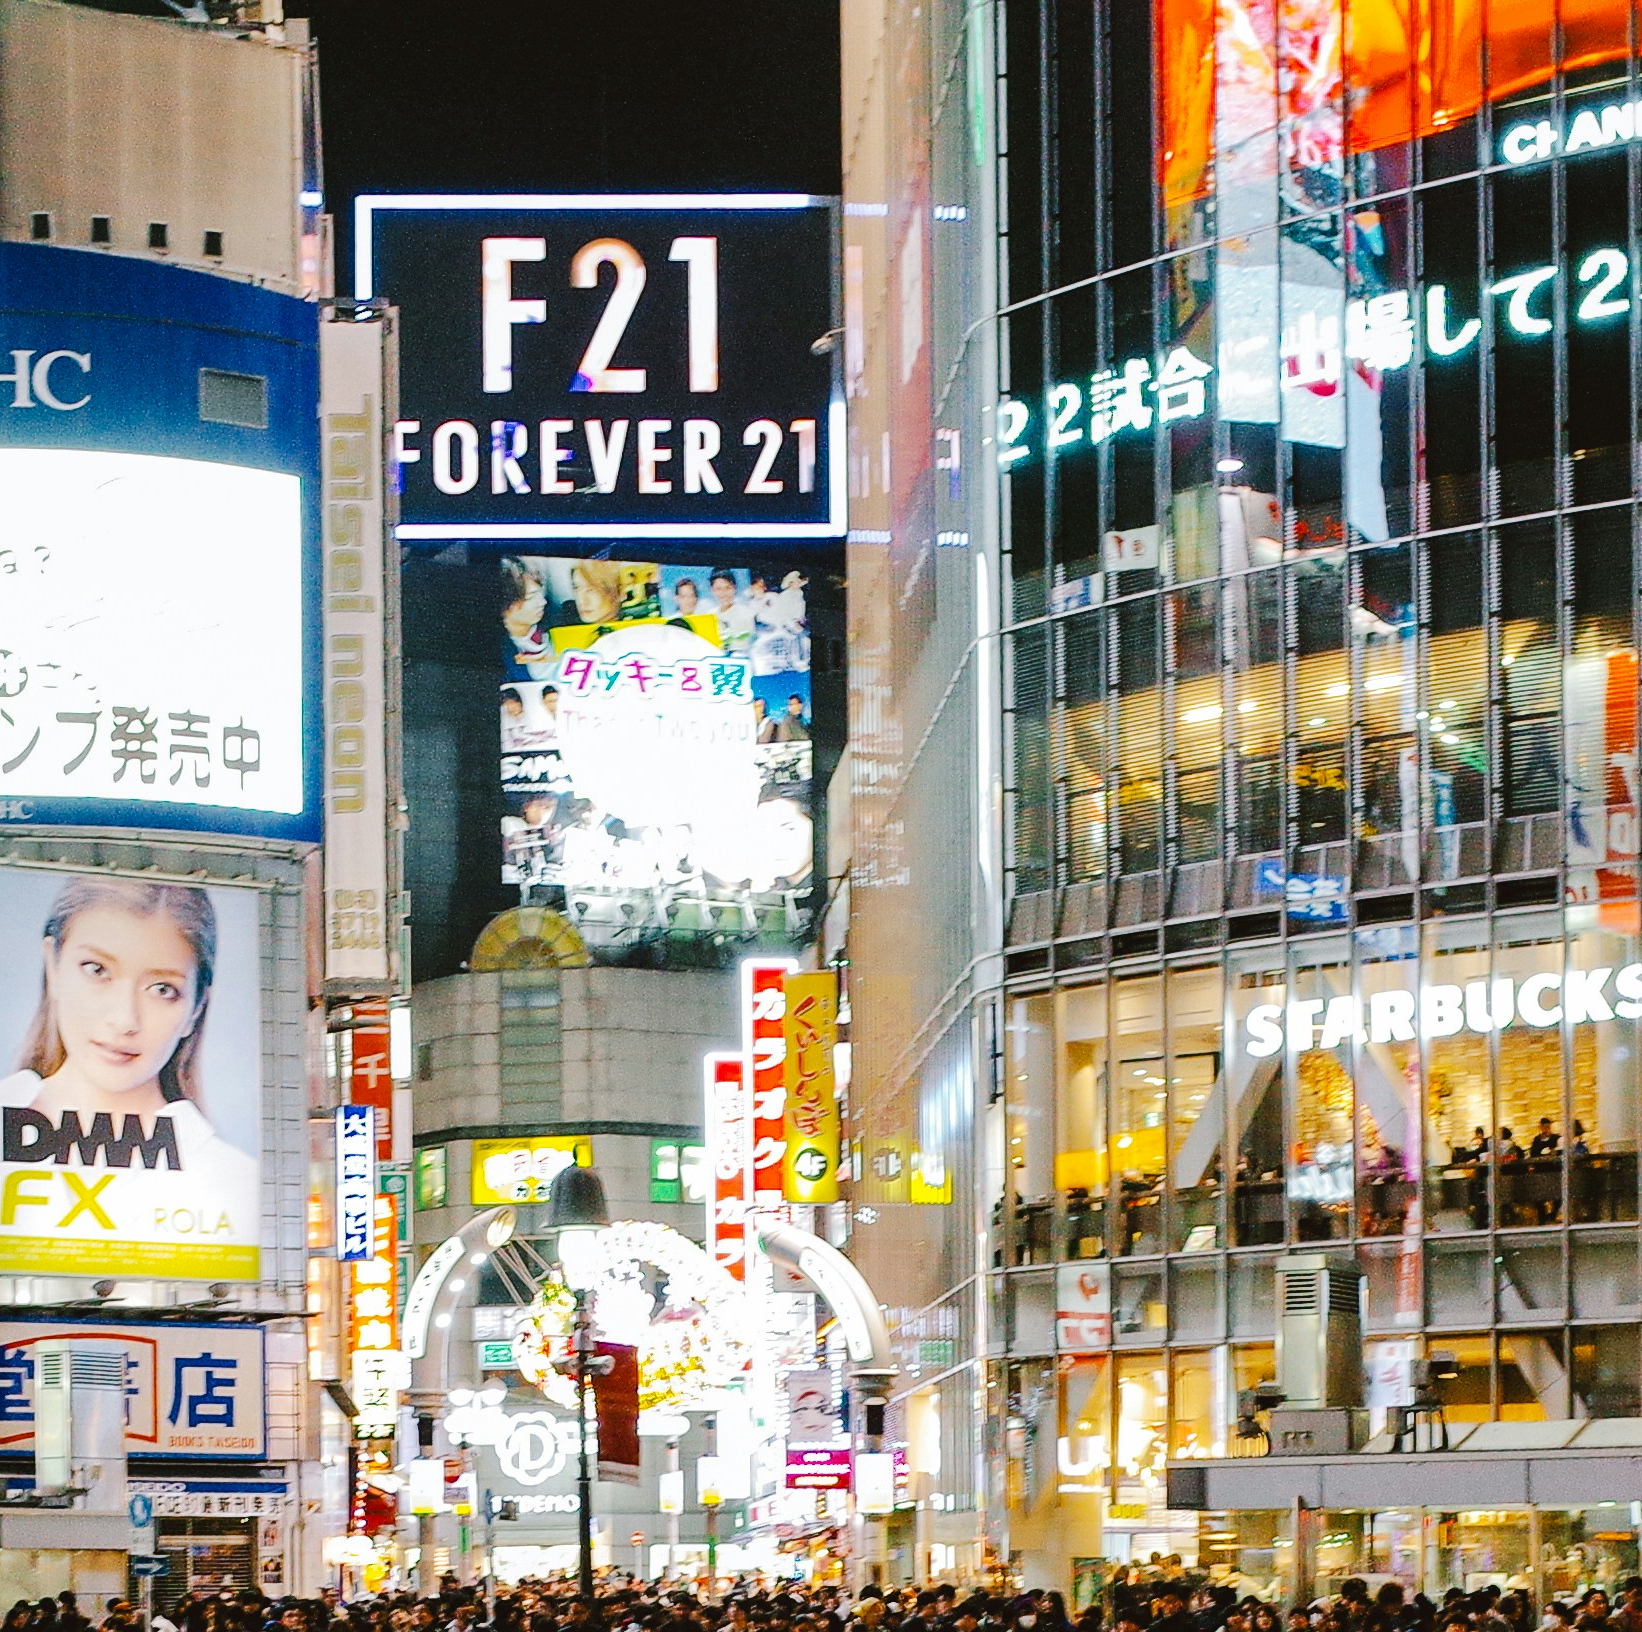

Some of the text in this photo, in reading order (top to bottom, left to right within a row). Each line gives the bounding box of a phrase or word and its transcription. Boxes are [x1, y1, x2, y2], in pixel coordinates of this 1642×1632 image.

[483, 237, 719, 393] F21
[394, 420, 817, 495] FOREVER 21
[330, 393, 375, 815] Taisei neon
[2, 1106, 183, 1171] DMM
[0, 1169, 235, 1235] FX ROLA
